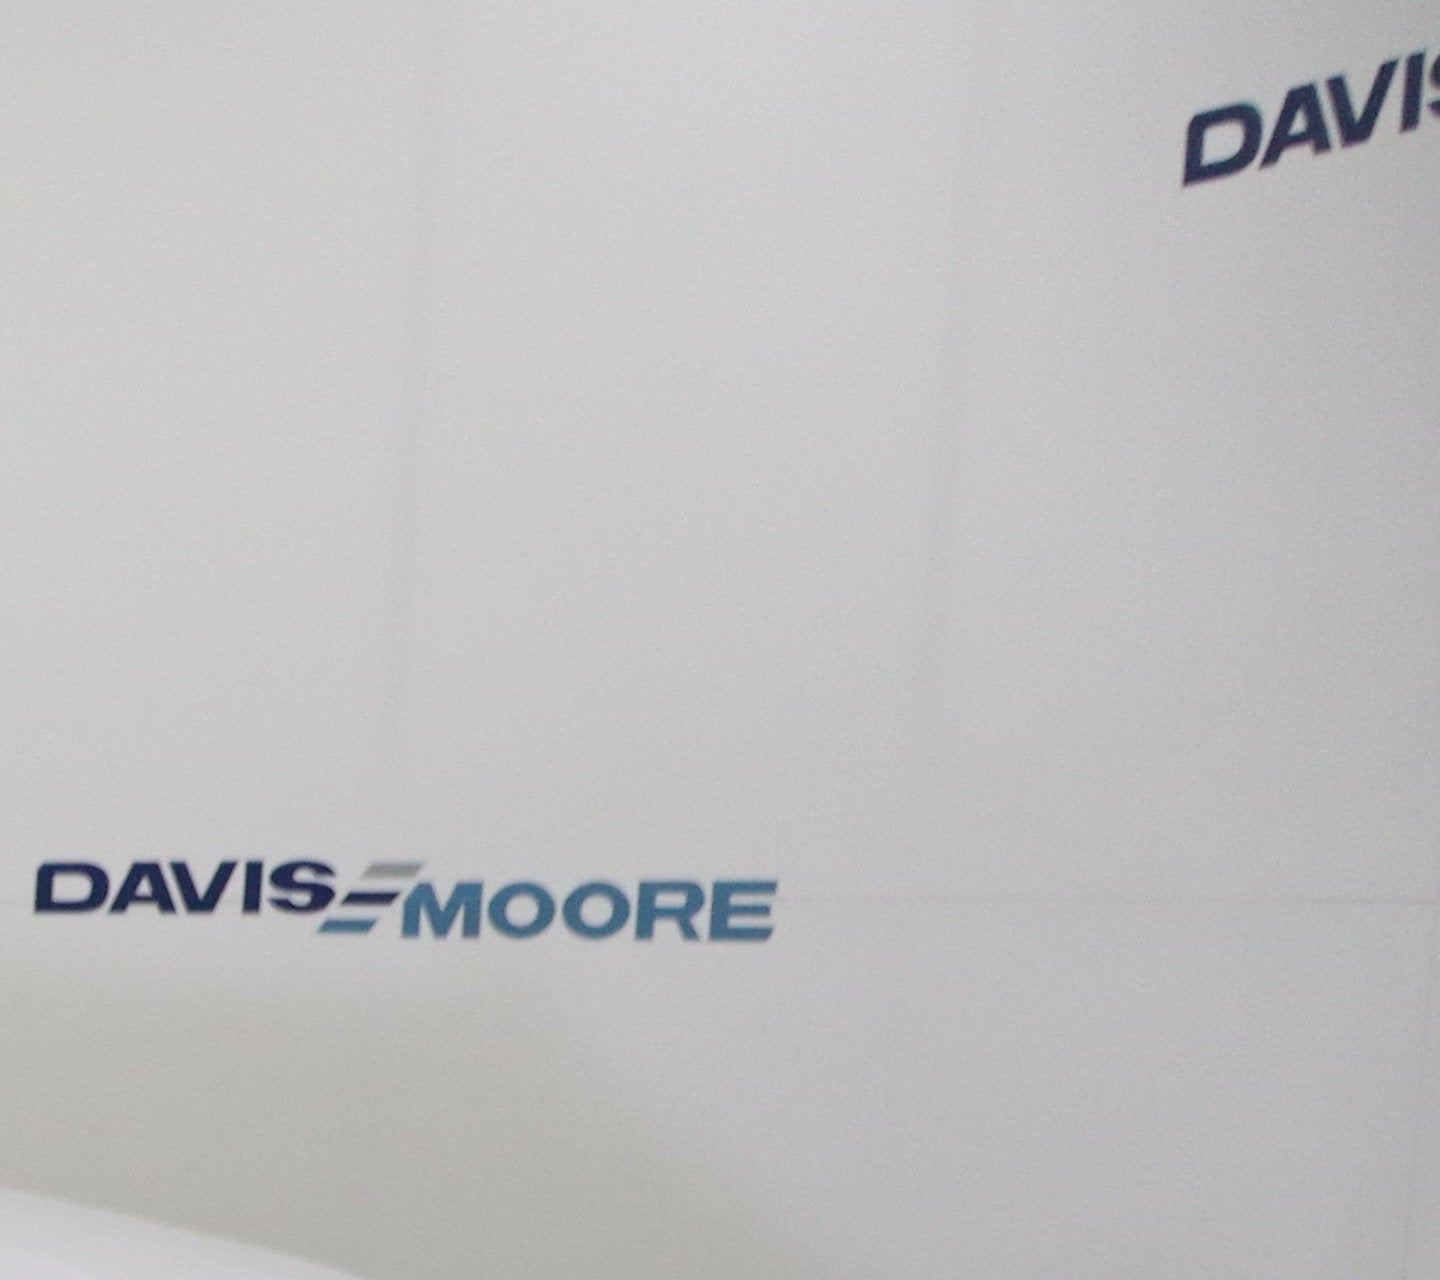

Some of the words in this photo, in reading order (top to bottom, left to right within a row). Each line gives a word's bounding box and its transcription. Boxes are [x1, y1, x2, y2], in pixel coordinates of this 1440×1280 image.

[1183, 49, 1440, 187] DAVI
[34, 860, 337, 915] DAVIS
[400, 880, 778, 942] MOORE
